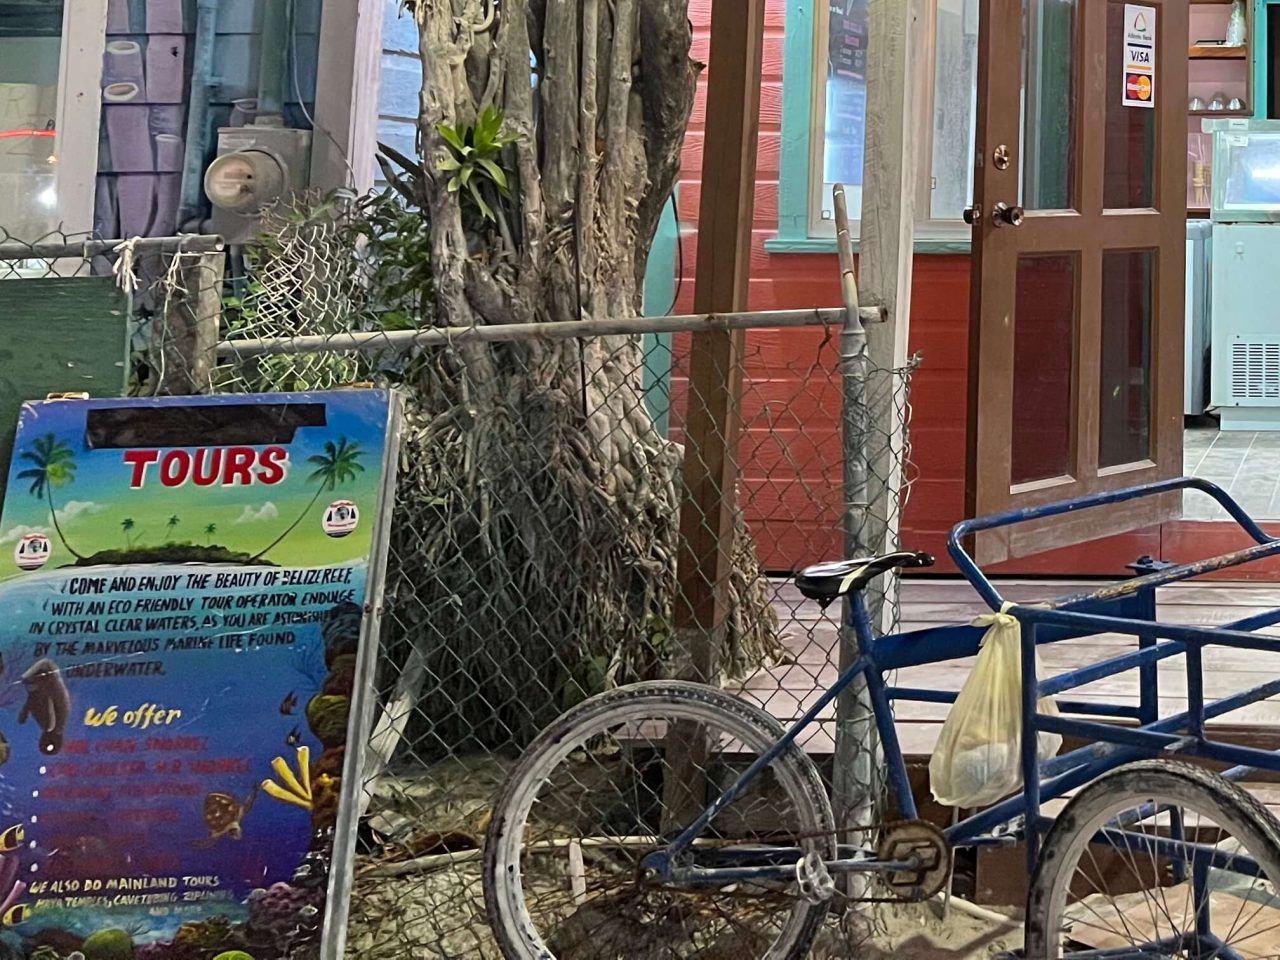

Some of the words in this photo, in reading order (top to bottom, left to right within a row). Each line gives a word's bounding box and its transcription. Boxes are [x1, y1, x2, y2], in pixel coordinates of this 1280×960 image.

[1131, 50, 1150, 63] VISA
[123, 447, 290, 489] TOURS
[69, 577, 107, 595] COME
[108, 576, 137, 593] AND
[137, 575, 181, 592] ENJOY
[186, 573, 211, 589] THE
[214, 572, 262, 589] BEAUTY
[263, 570, 281, 587] OF
[281, 569, 321, 586] BELIZE
[51, 600, 83, 616] WITH
[85, 599, 106, 616] AN
[107, 599, 132, 615] ECO
[134, 597, 195, 613] FRIENDLY
[201, 595, 236, 610] TOUR
[236, 591, 297, 610] OPERATOR
[301, 589, 356, 606] ENDULGE
[28, 620, 45, 635] IN
[48, 619, 99, 636] CRYSTAL
[104, 617, 142, 633] CLEAR
[145, 616, 199, 632] WATERS,
[201, 615, 218, 628] AS
[222, 613, 246, 628] YOU
[247, 612, 267, 626] ARE
[34, 642, 51, 657] BY
[56, 641, 79, 656] THE
[164, 636, 214, 651] MARINE
[218, 633, 242, 649] LIFE
[248, 631, 296, 646] FOUND
[84, 705, 120, 727] We
[122, 701, 182, 730] offer
[29, 880, 49, 894] WE
[50, 878, 80, 893] ALSO
[83, 878, 103, 892] DO
[105, 877, 178, 891] MAINLAND
[182, 874, 220, 888] TOURS
